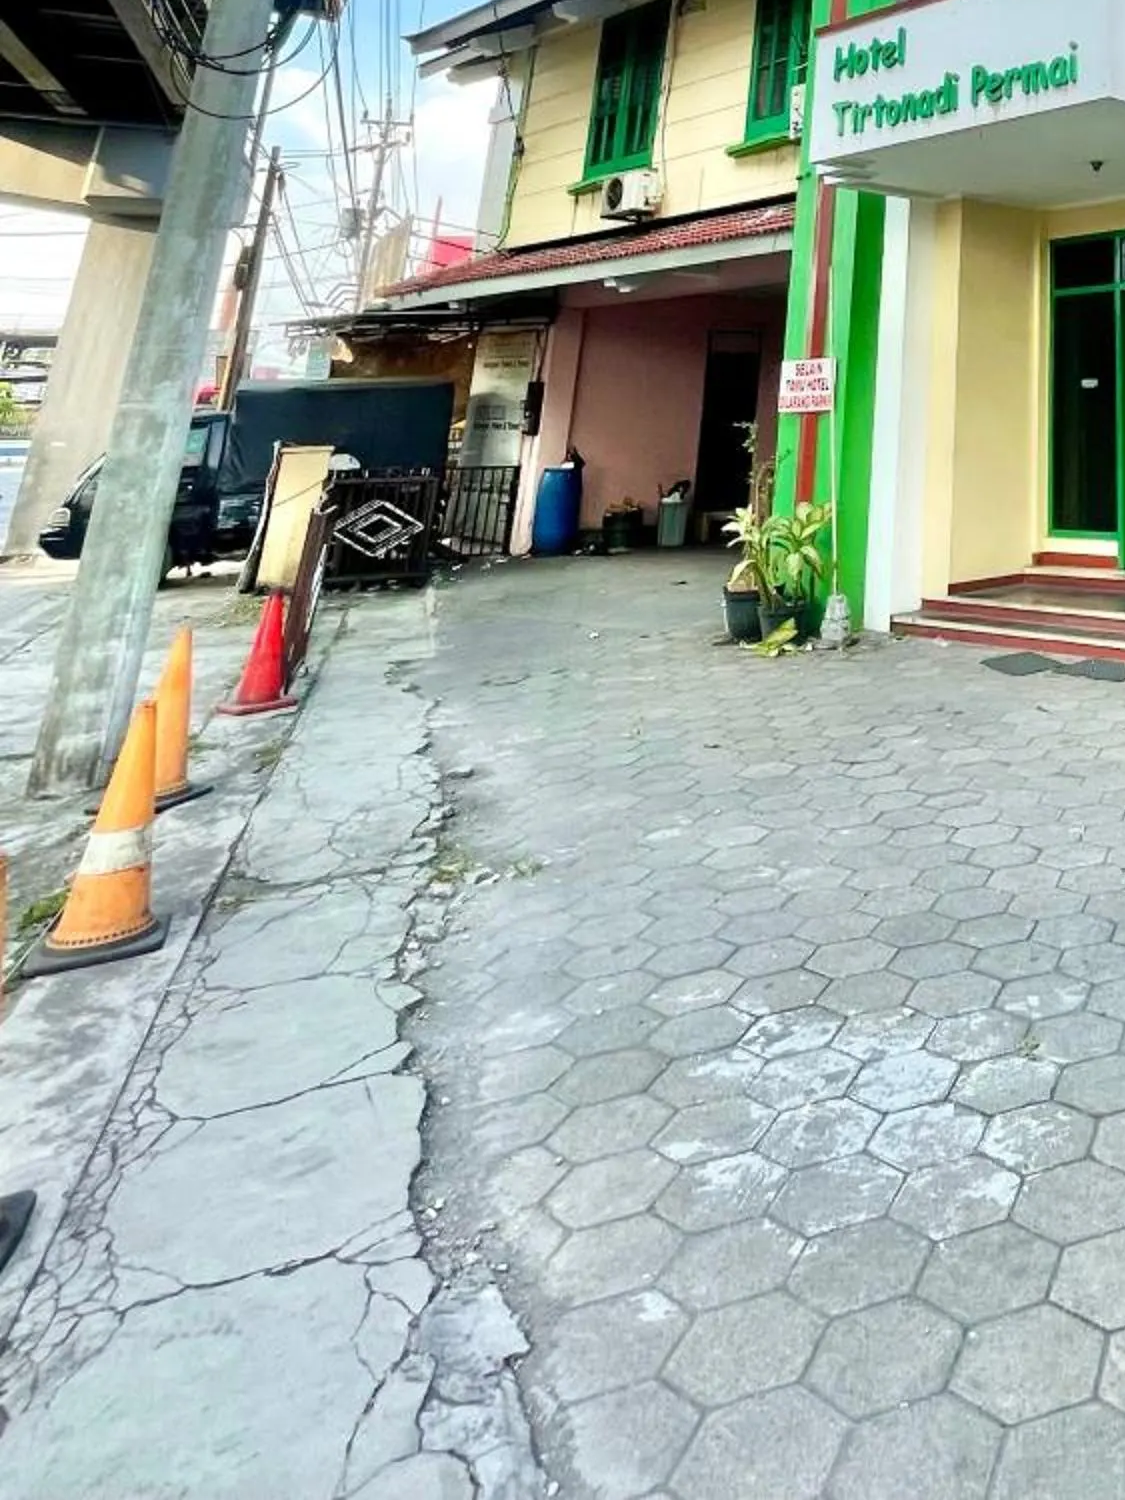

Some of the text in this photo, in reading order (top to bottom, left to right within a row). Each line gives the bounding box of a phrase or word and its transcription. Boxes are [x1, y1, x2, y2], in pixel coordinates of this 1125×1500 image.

[832, 41, 1079, 136] Tirtonadi Permai
[834, 27, 906, 82] Hotel
